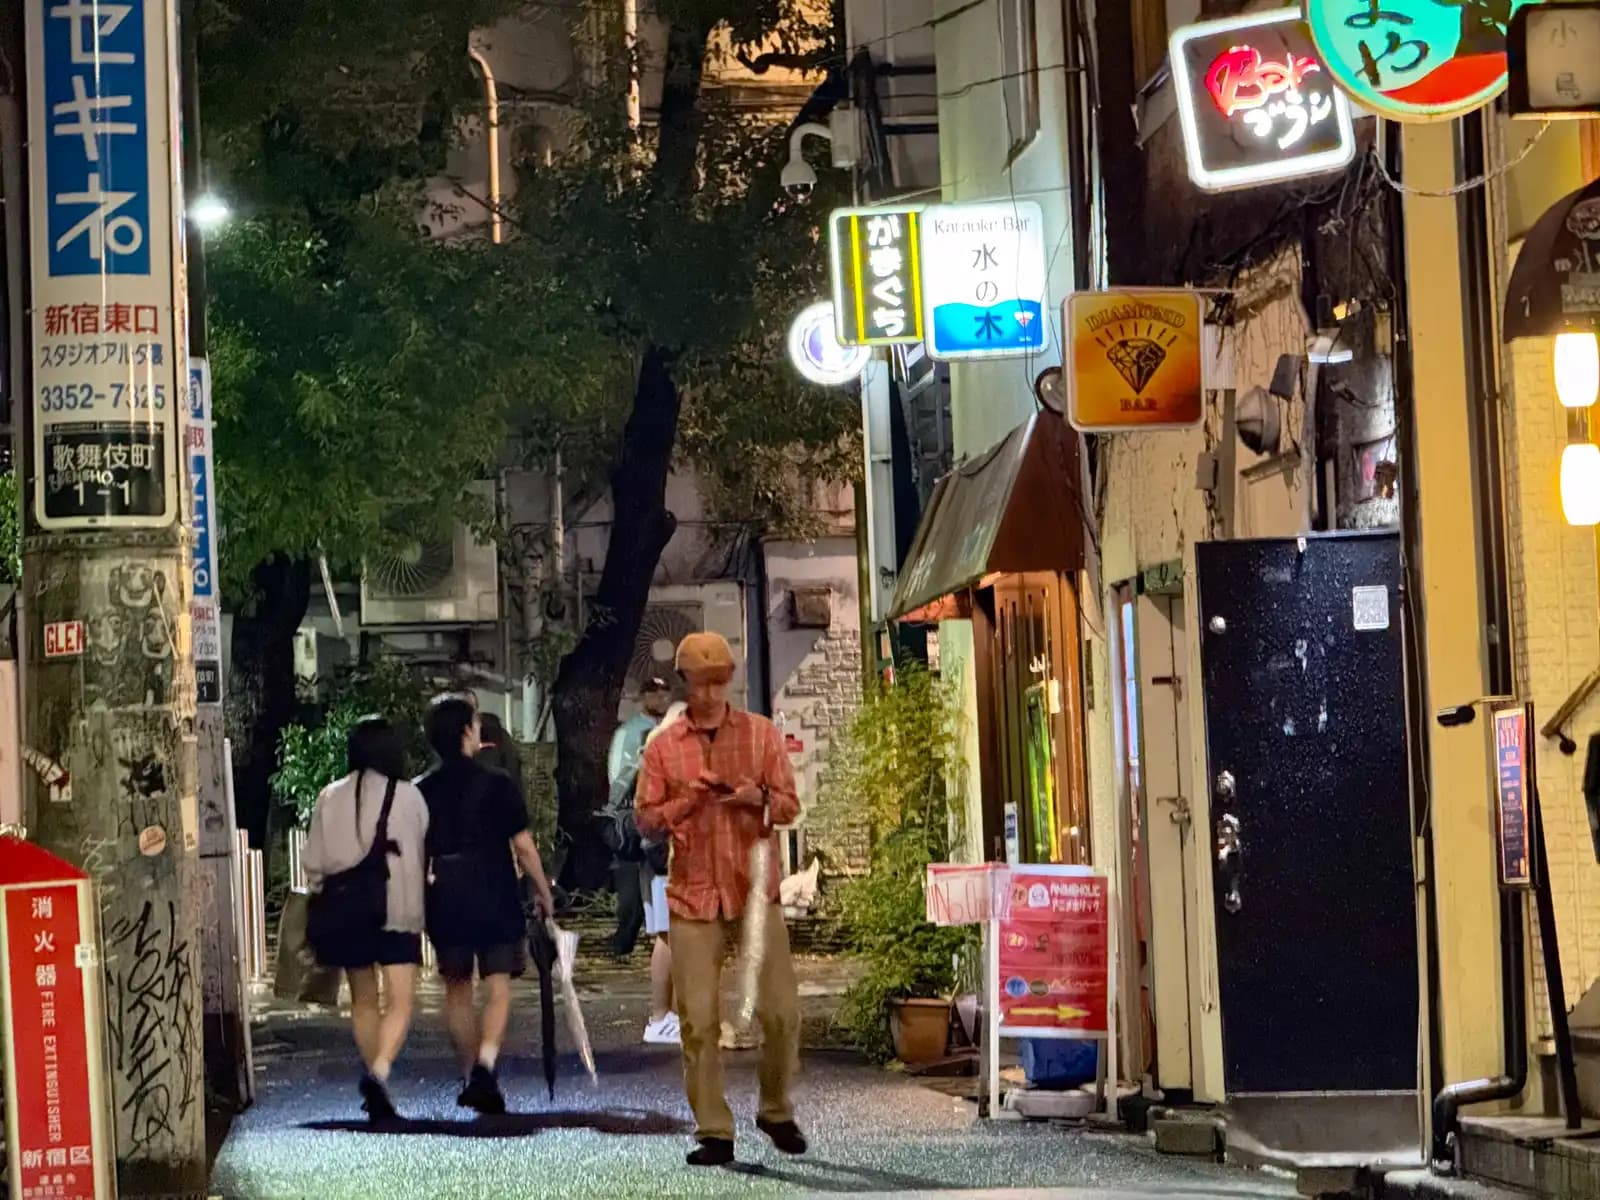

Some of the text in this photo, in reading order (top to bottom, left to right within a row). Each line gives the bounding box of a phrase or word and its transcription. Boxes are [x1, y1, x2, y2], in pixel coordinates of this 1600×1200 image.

[51, 0, 143, 260] セキネ
[934, 215, 1031, 235] Karaoke Bar
[971, 243, 1003, 341] 水の木
[44, 302, 159, 336] 新宿東口
[1085, 302, 1186, 333] DIAMOND
[1120, 397, 1158, 412] BAR
[53, 442, 155, 471] 歌舞伎町
[32, 895, 57, 987] 消火器
[41, 990, 56, 1028] FIRE
[21, 1144, 92, 1169] 新宿区
